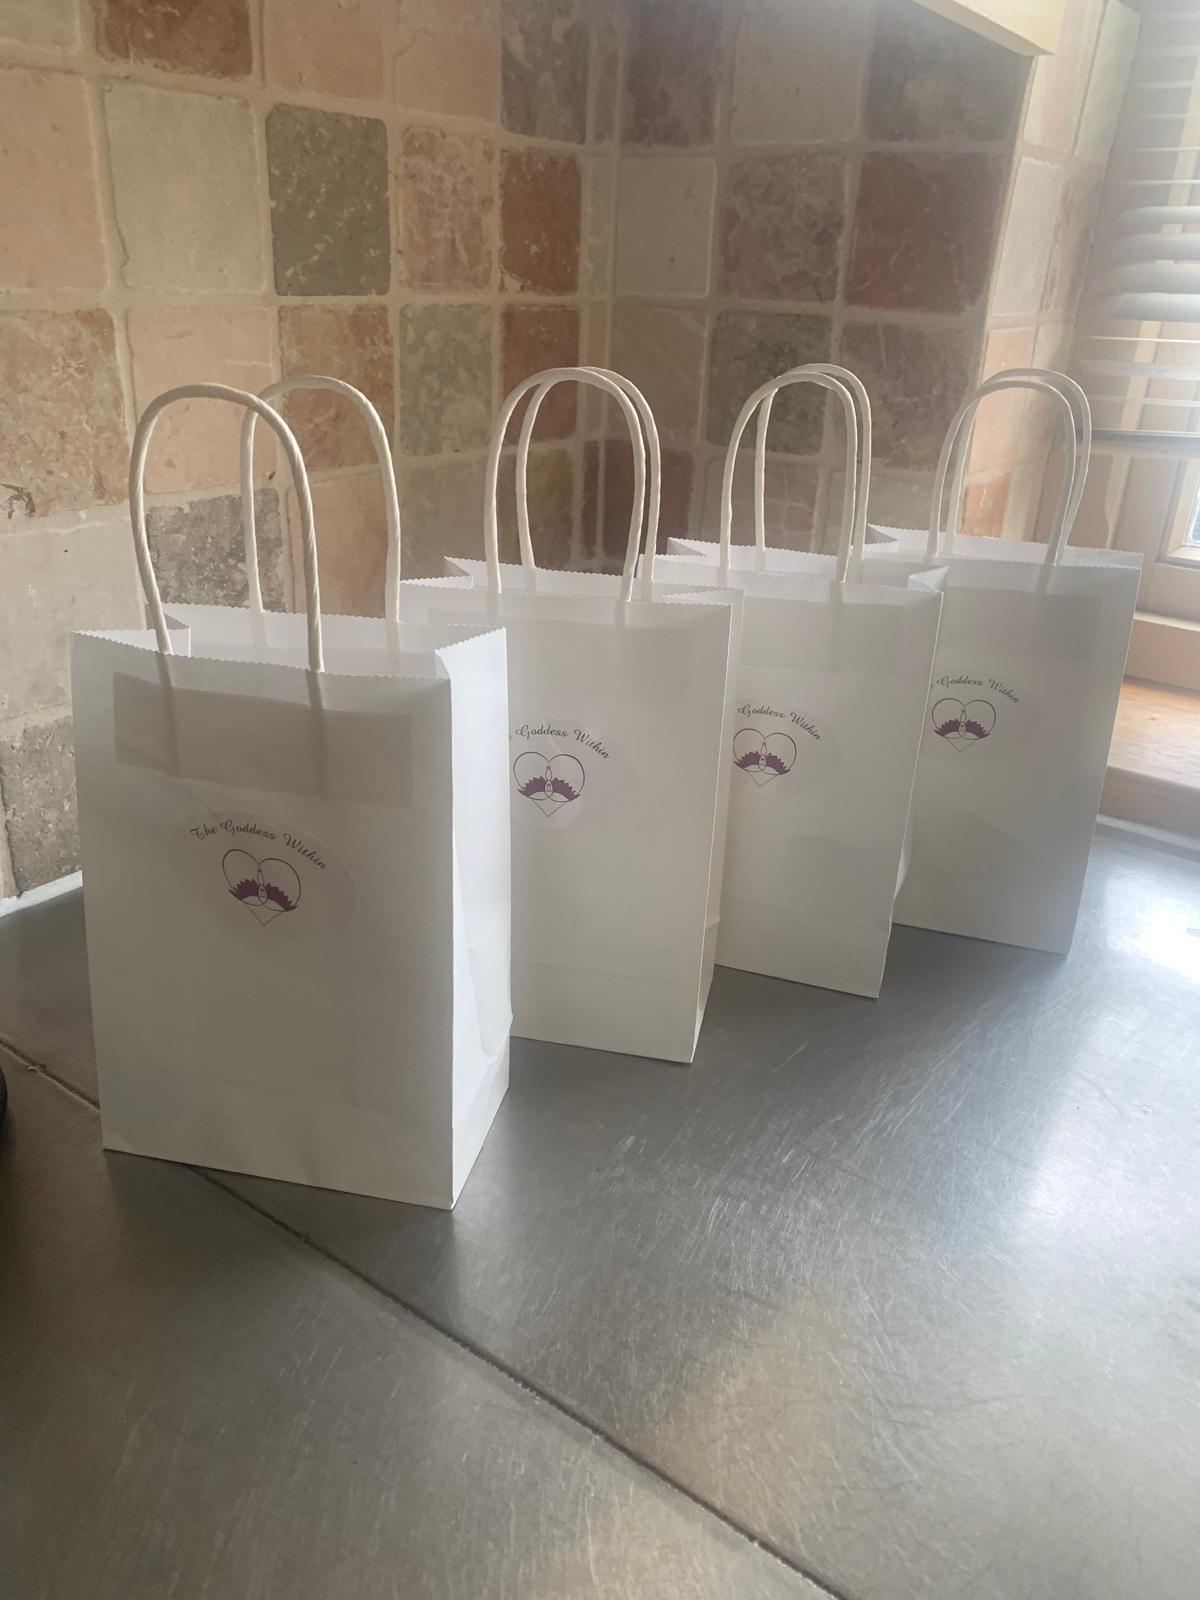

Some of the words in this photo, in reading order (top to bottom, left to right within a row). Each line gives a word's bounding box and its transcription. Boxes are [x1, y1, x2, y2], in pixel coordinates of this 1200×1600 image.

[936, 675, 982, 688] Goddess
[989, 679, 1019, 703] Within
[737, 704, 785, 718] Goddess
[790, 711, 821, 740] Within
[515, 724, 569, 740] Goddess
[574, 728, 610, 759] Within
[190, 824, 216, 840] The
[220, 819, 277, 840] Goddess
[282, 832, 326, 869] Within
